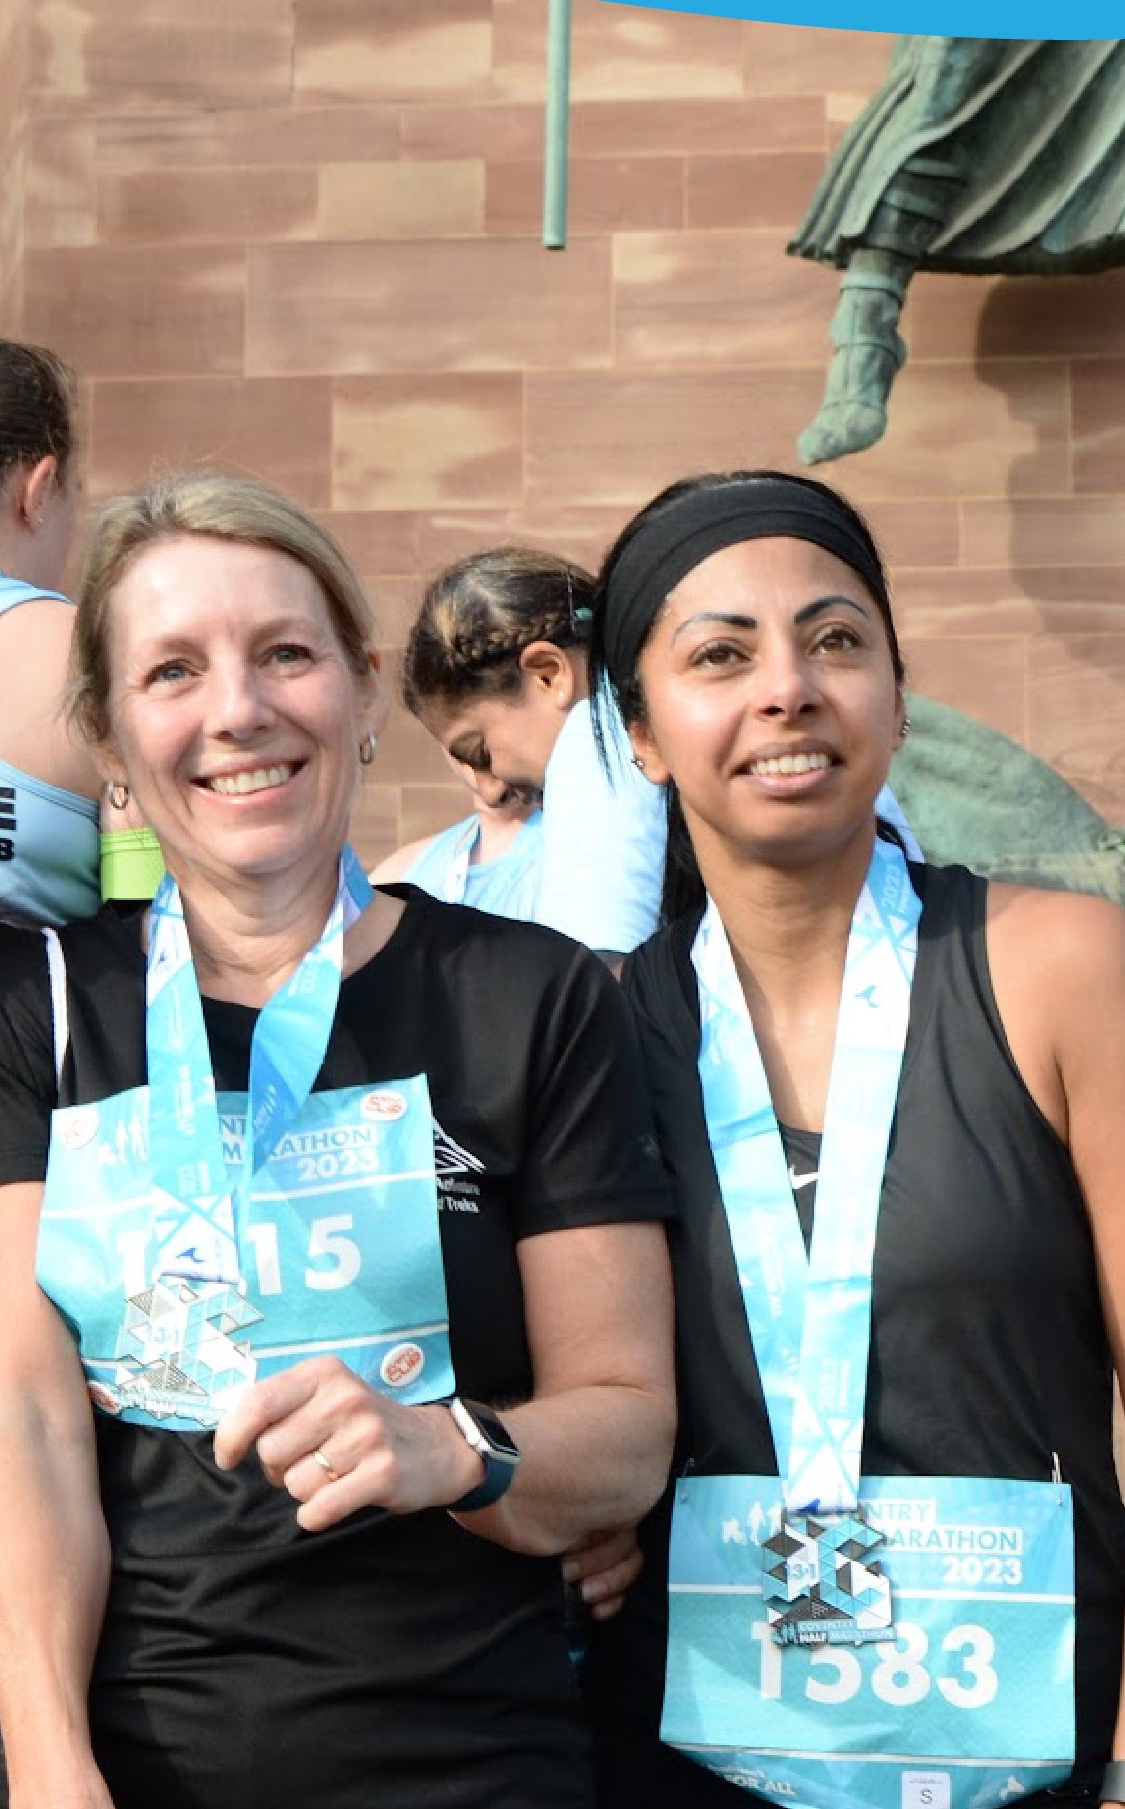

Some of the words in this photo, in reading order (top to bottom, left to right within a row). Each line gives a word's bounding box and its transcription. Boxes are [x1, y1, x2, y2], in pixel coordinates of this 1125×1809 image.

[297, 1151, 379, 1182] 2023
[116, 1214, 363, 1296] 115
[866, 1503, 930, 1521] NTRY
[887, 1528, 1017, 1551] ARATHON
[941, 1556, 1024, 1585] 2023
[751, 1620, 999, 1709] 1583
[919, 1788, 933, 1805] S
